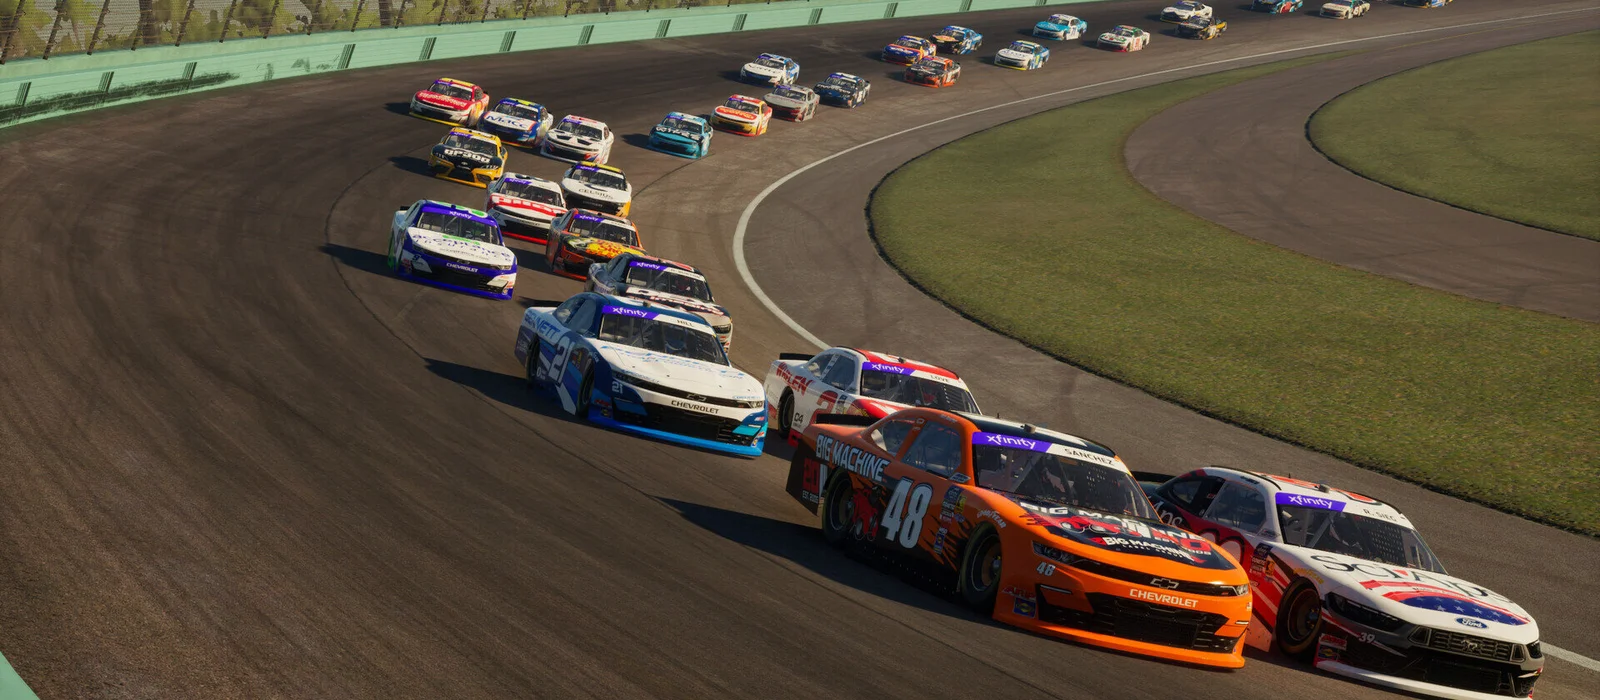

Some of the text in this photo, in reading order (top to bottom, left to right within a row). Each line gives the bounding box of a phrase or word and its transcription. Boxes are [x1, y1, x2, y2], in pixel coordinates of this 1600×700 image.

[446, 262, 479, 273] CHEVROLET
[636, 261, 661, 270] xfinity
[612, 306, 648, 318] xfinity
[548, 334, 576, 383] 21
[871, 363, 905, 374] xfinity
[611, 382, 624, 395] 21
[671, 400, 720, 415] CHEVROLET
[986, 434, 1036, 450] xfinity
[815, 433, 834, 461] BIG
[832, 441, 892, 483] MACHINE
[1063, 447, 1115, 466] SANCHEZ
[1288, 494, 1333, 509] xfinity
[881, 476, 934, 549] 48
[1375, 511, 1397, 522] SIEG
[1102, 536, 1129, 546] BIG
[1036, 561, 1057, 576] 48
[1130, 588, 1199, 609] CHEVROLET
[1461, 617, 1485, 629] Ford
[1358, 631, 1377, 644] 39
